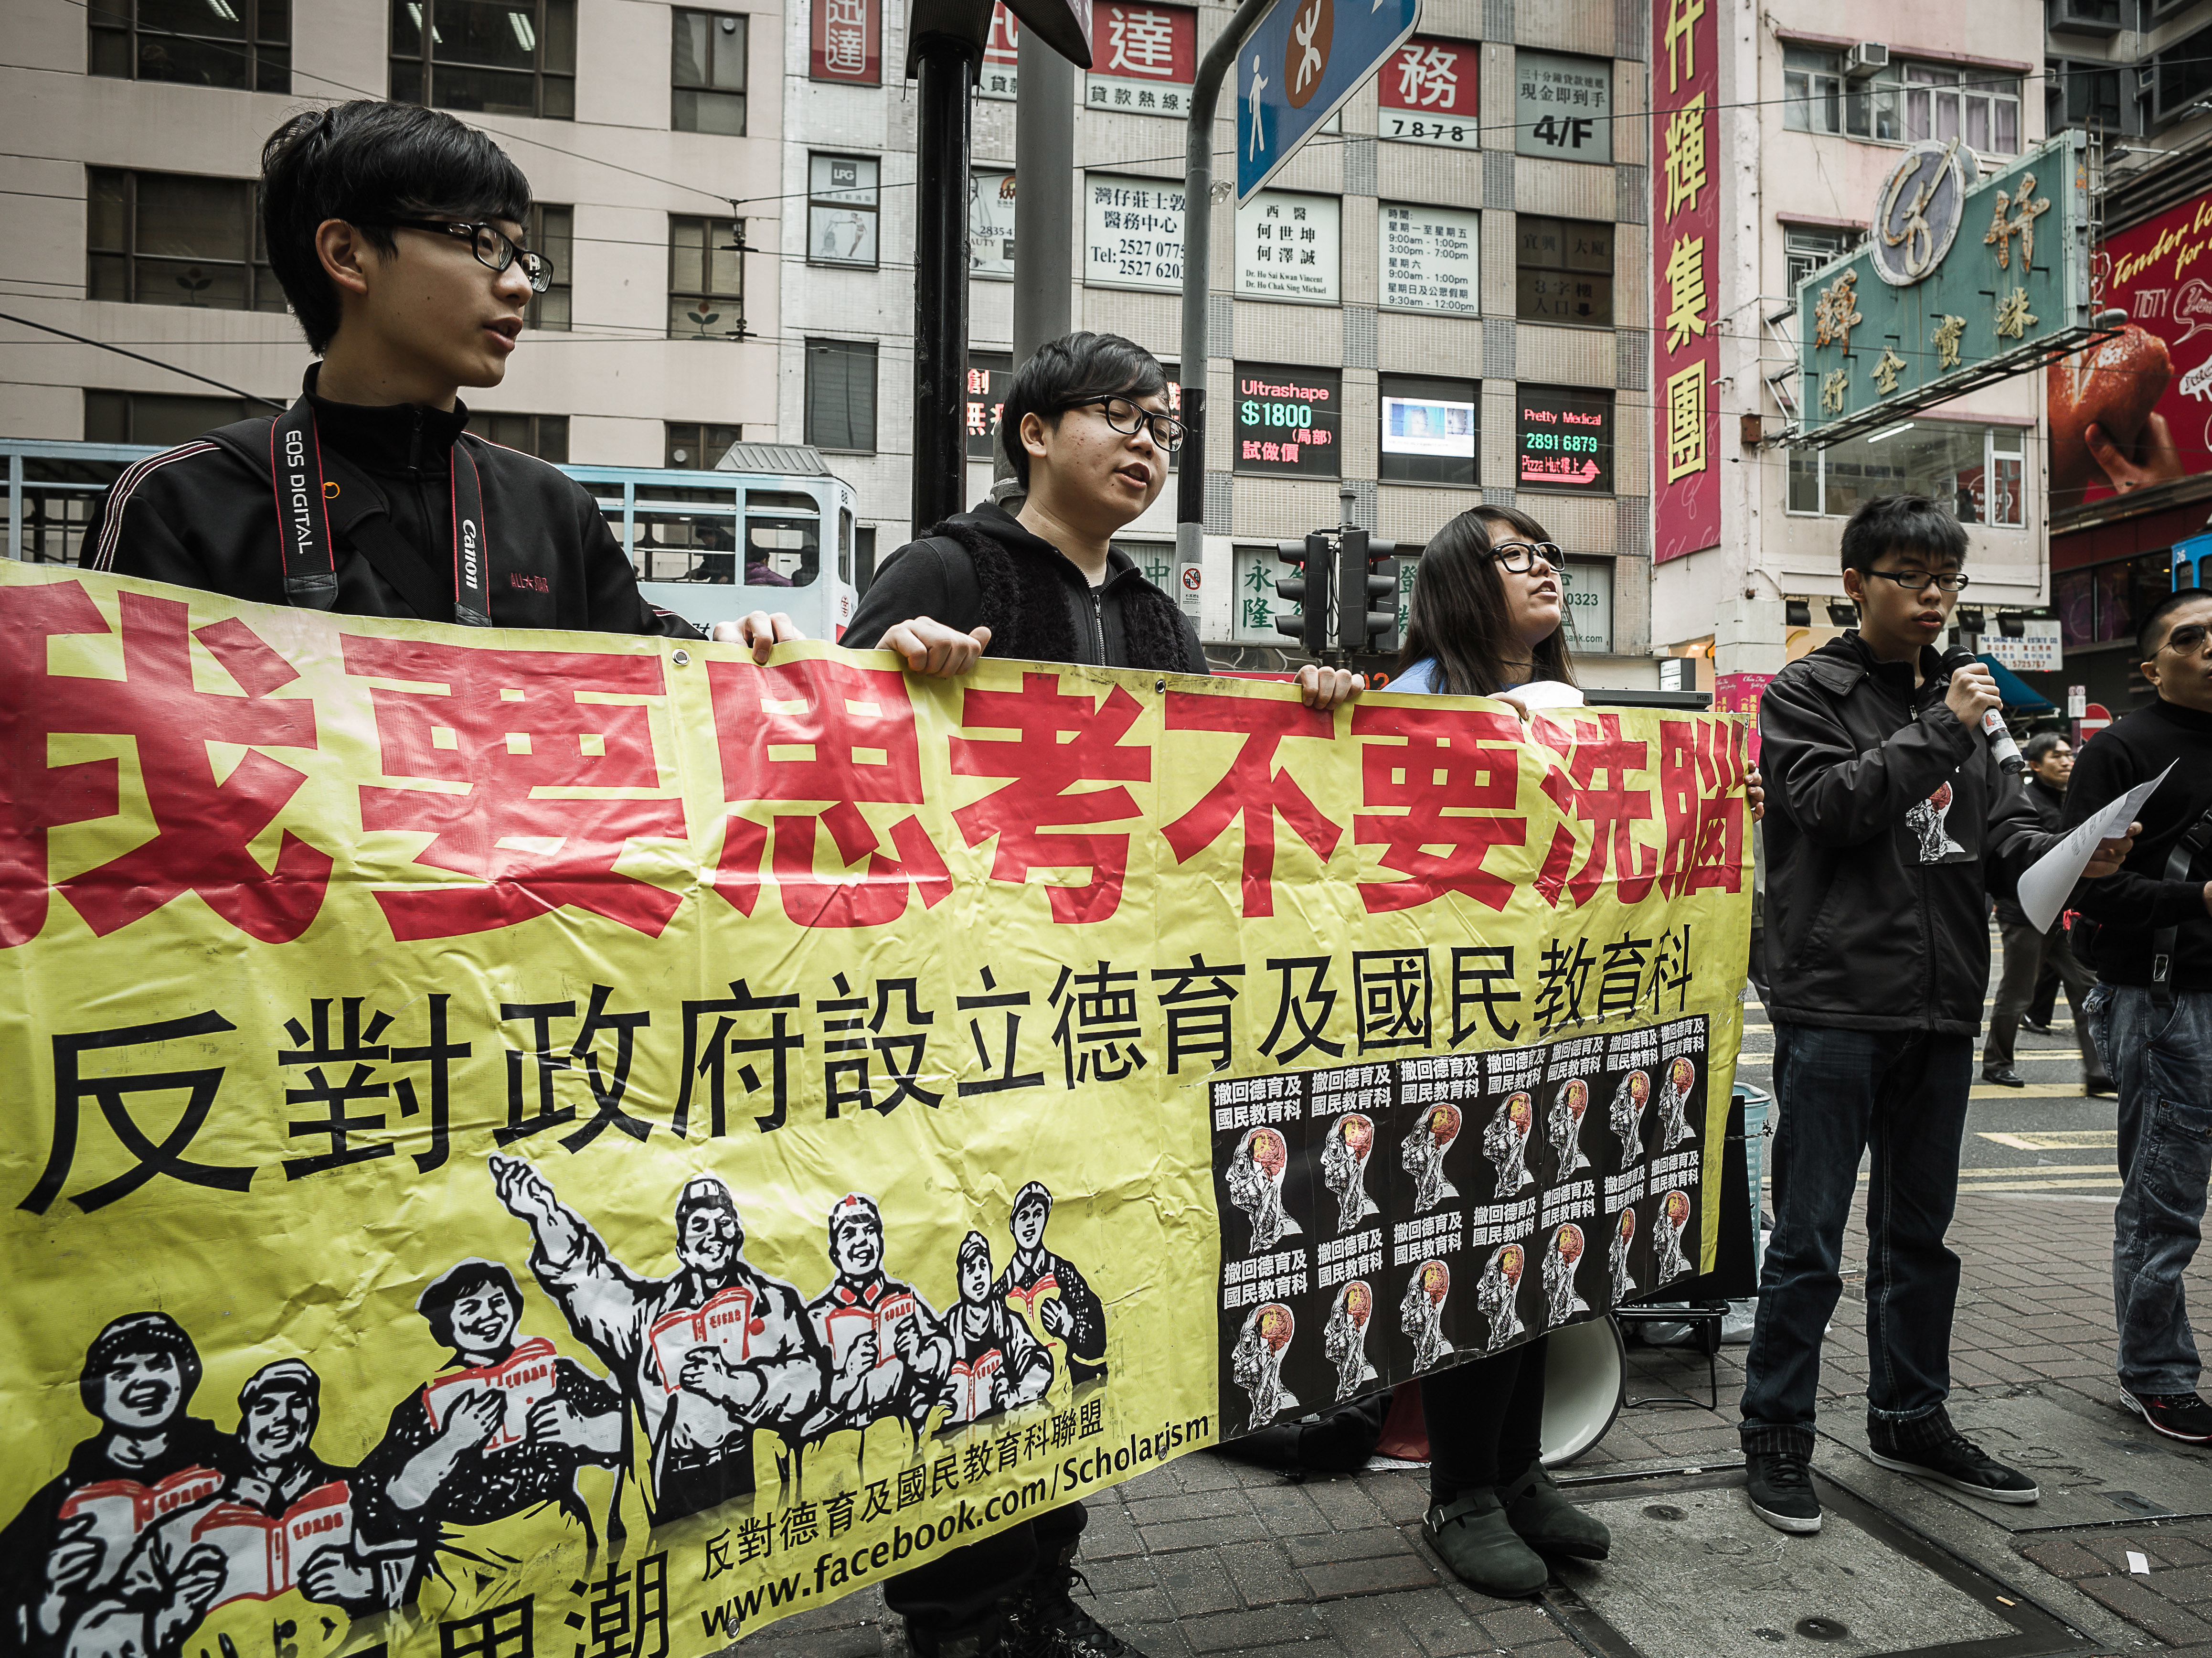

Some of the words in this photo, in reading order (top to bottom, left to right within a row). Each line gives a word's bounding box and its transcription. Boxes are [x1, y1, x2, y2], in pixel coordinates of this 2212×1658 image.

[1108, 7, 1173, 75] 達
[1398, 44, 1458, 108] 務
[1521, 83, 1605, 107] 現金即到手
[1392, 119, 1464, 142] 7878
[1533, 115, 1593, 149] 4/F
[833, 169, 855, 181] LPG
[1095, 187, 1185, 212] 灣仔莊士敦
[1266, 204, 1306, 220] 西醫
[1104, 210, 1177, 233] 醫務中心
[1257, 223, 1315, 243] 何世坤
[1389, 221, 1467, 238] 星期一至星期五
[1091, 246, 1117, 263] Tel:
[1119, 239, 1151, 256] 2527
[1257, 245, 1315, 265] 何澤誠
[1389, 234, 1423, 245] 9:00am
[1435, 238, 1468, 249] 1:00pm
[1389, 244, 1424, 256] 3:00pm
[1435, 249, 1468, 260] 7:00pm
[1119, 259, 1151, 276] 2527
[1389, 257, 1421, 269] 星期六
[2113, 223, 2190, 289] Tender
[2175, 240, 2205, 280] for
[1268, 282, 1285, 290] Chak
[1287, 285, 1300, 294] Sing
[1302, 285, 1327, 294] Michael
[1280, 273, 1297, 281] Kwan
[1299, 274, 1323, 283] Vincent
[1389, 269, 1423, 280] 9:00am
[1435, 274, 1468, 284] 1:00pm
[1388, 282, 1468, 299] 星期日及公眾假期
[1389, 295, 1423, 306] 9:30am
[1435, 300, 1475, 311] 12:00pm
[1242, 379, 1329, 403] Ultrashape
[1241, 399, 1312, 428] $1800
[1524, 408, 1558, 425] Pretty
[1563, 411, 1602, 426] Medical
[286, 430, 304, 468] EOS
[1292, 428, 1332, 445] (局部)
[1526, 432, 1559, 450] 2891
[1563, 435, 1597, 453] 6879
[1242, 440, 1299, 463] 試做價
[1521, 455, 1543, 472] Pizza
[841, 490, 848, 504] 88
[290, 474, 312, 554] DIGITAL
[462, 519, 479, 590] Canon
[510, 572, 526, 588] ALL
[534, 575, 549, 593] STAR
[0, 578, 1744, 950] 我要思考不要洗腦
[1609, 1028, 1658, 1053] 撤回德育及
[1661, 1017, 1705, 1042] 撤回德育及
[1487, 1048, 1546, 1074] 撤回德育及
[1552, 1036, 1605, 1063] 撤回德育及
[1606, 1049, 1659, 1071] 國民教育科
[1662, 1035, 1705, 1061] 國民教育科
[17, 923, 1694, 1215] 反對政府設立德育及國民教育科
[1312, 1064, 1392, 1094] 撤回德育及
[1401, 1055, 1479, 1082] 撤回德育及
[1547, 1055, 1601, 1082] 國民教育科
[1214, 1075, 1302, 1107] 撤回德育及
[1311, 1087, 1392, 1118] 國民教育科
[1401, 1078, 1479, 1105] 國民教育科
[1215, 1099, 1302, 1132] 國民教育科
[1651, 1150, 1700, 1177] 撤回德育及
[1604, 1165, 1646, 1195] 撤回德育及
[1650, 1167, 1699, 1195] 國民教育科
[1542, 1179, 1596, 1210] 撤回德育及
[1604, 1184, 1645, 1215] 國民教育科
[1474, 1196, 1537, 1227] 撤回德育及
[1541, 1198, 1596, 1230] 國民教育科
[1393, 1210, 1463, 1244] 撤回德育及
[1318, 1228, 1383, 1266] 撤回德育及
[1393, 1231, 1462, 1266] 國民教育科
[1224, 1249, 1308, 1286] 撤回德育及
[1318, 1251, 1383, 1289] 國民教育科
[1223, 1271, 1308, 1310] 國民教育科
[702, 1398, 1104, 1582] 反對德育及國民教育科聯盟
[701, 1414, 1210, 1637] www.facebook.com/Scholarism
